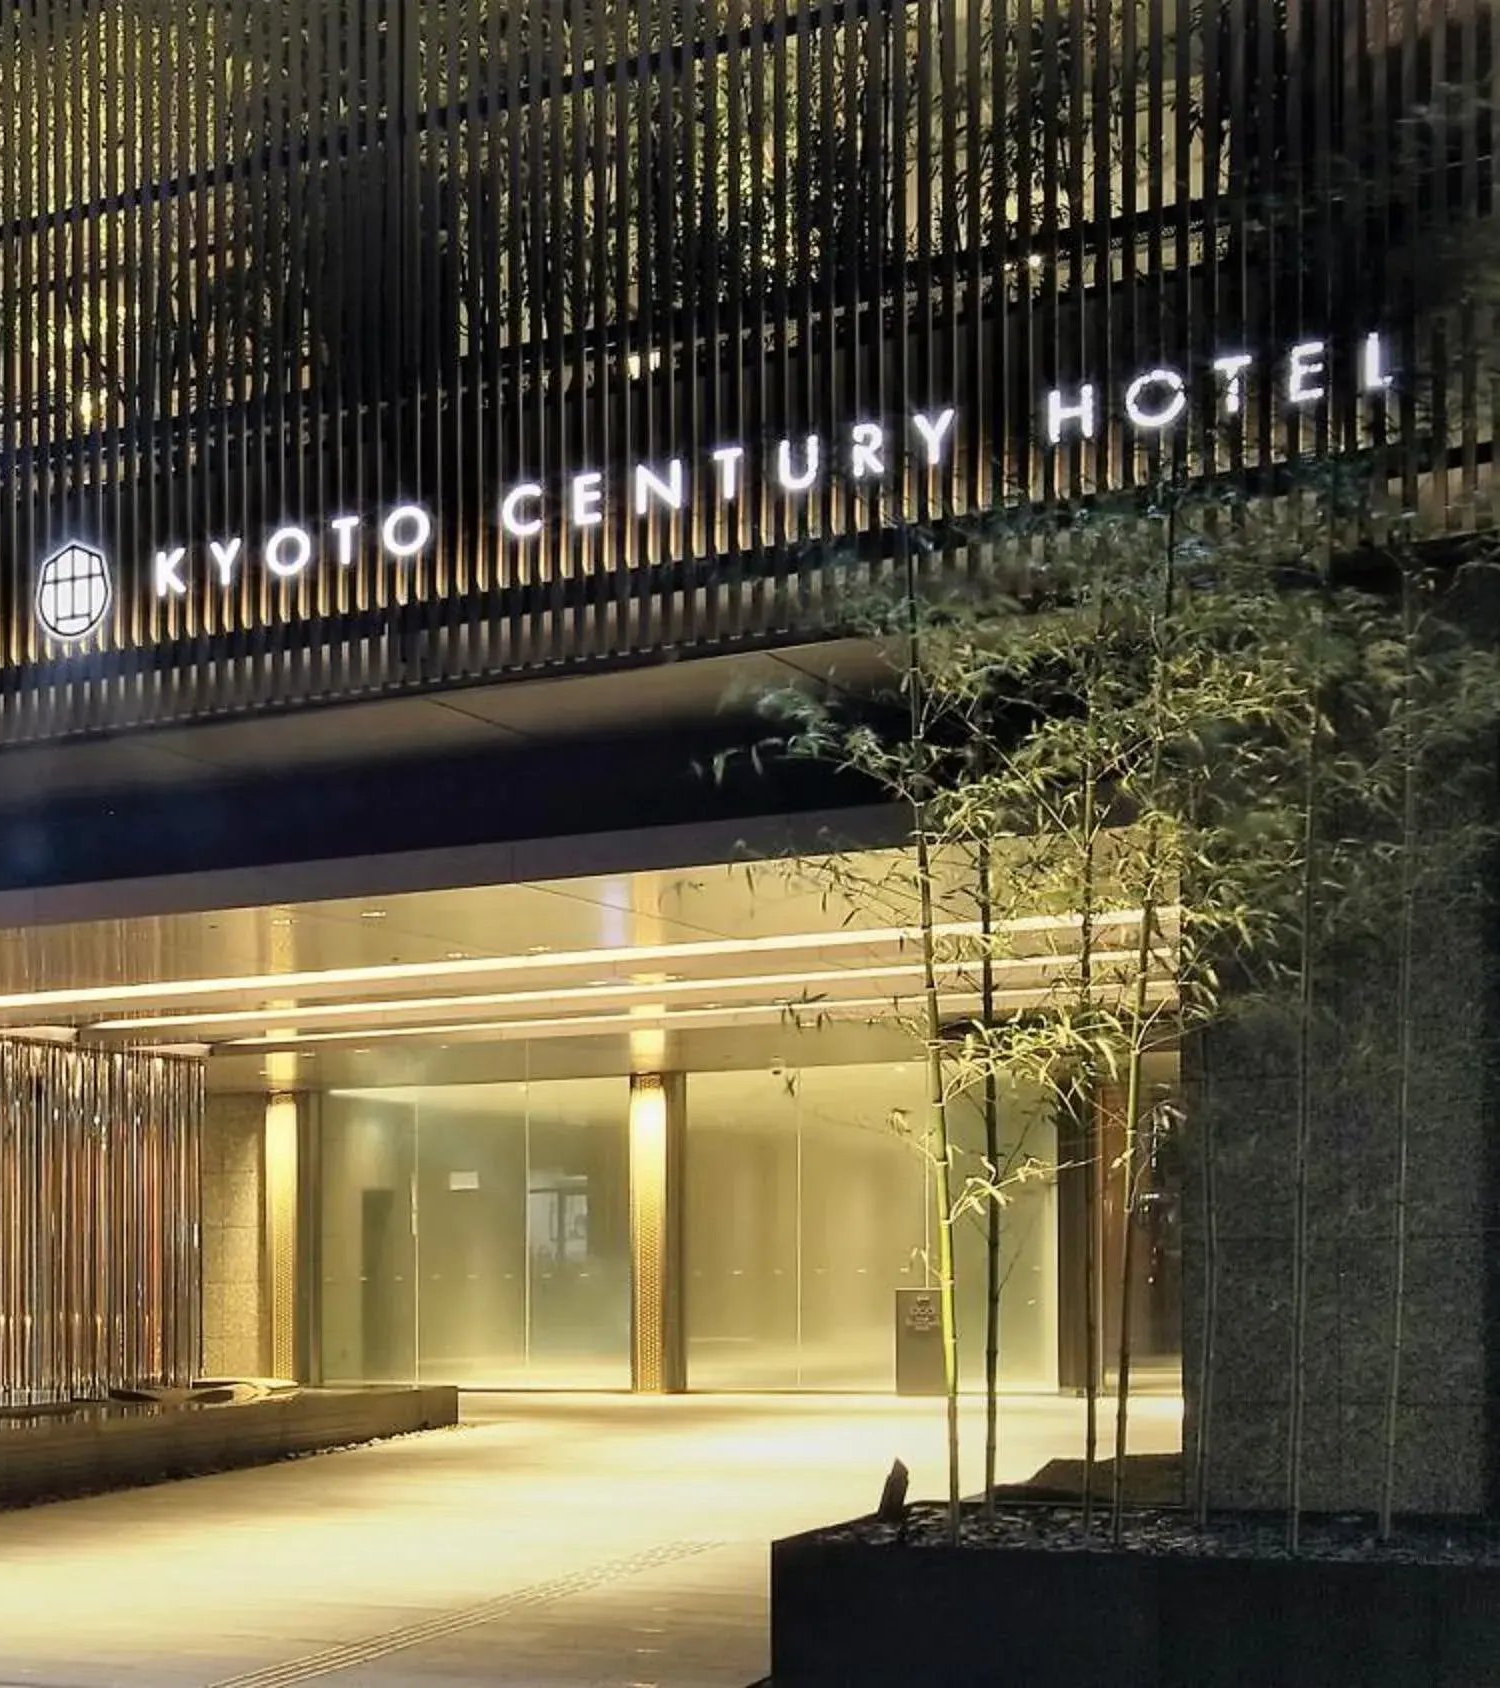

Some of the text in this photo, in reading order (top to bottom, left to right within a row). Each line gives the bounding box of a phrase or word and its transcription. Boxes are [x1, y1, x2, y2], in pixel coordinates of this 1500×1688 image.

[153, 331, 1393, 598] KYOTO CENTURY HOTEL
